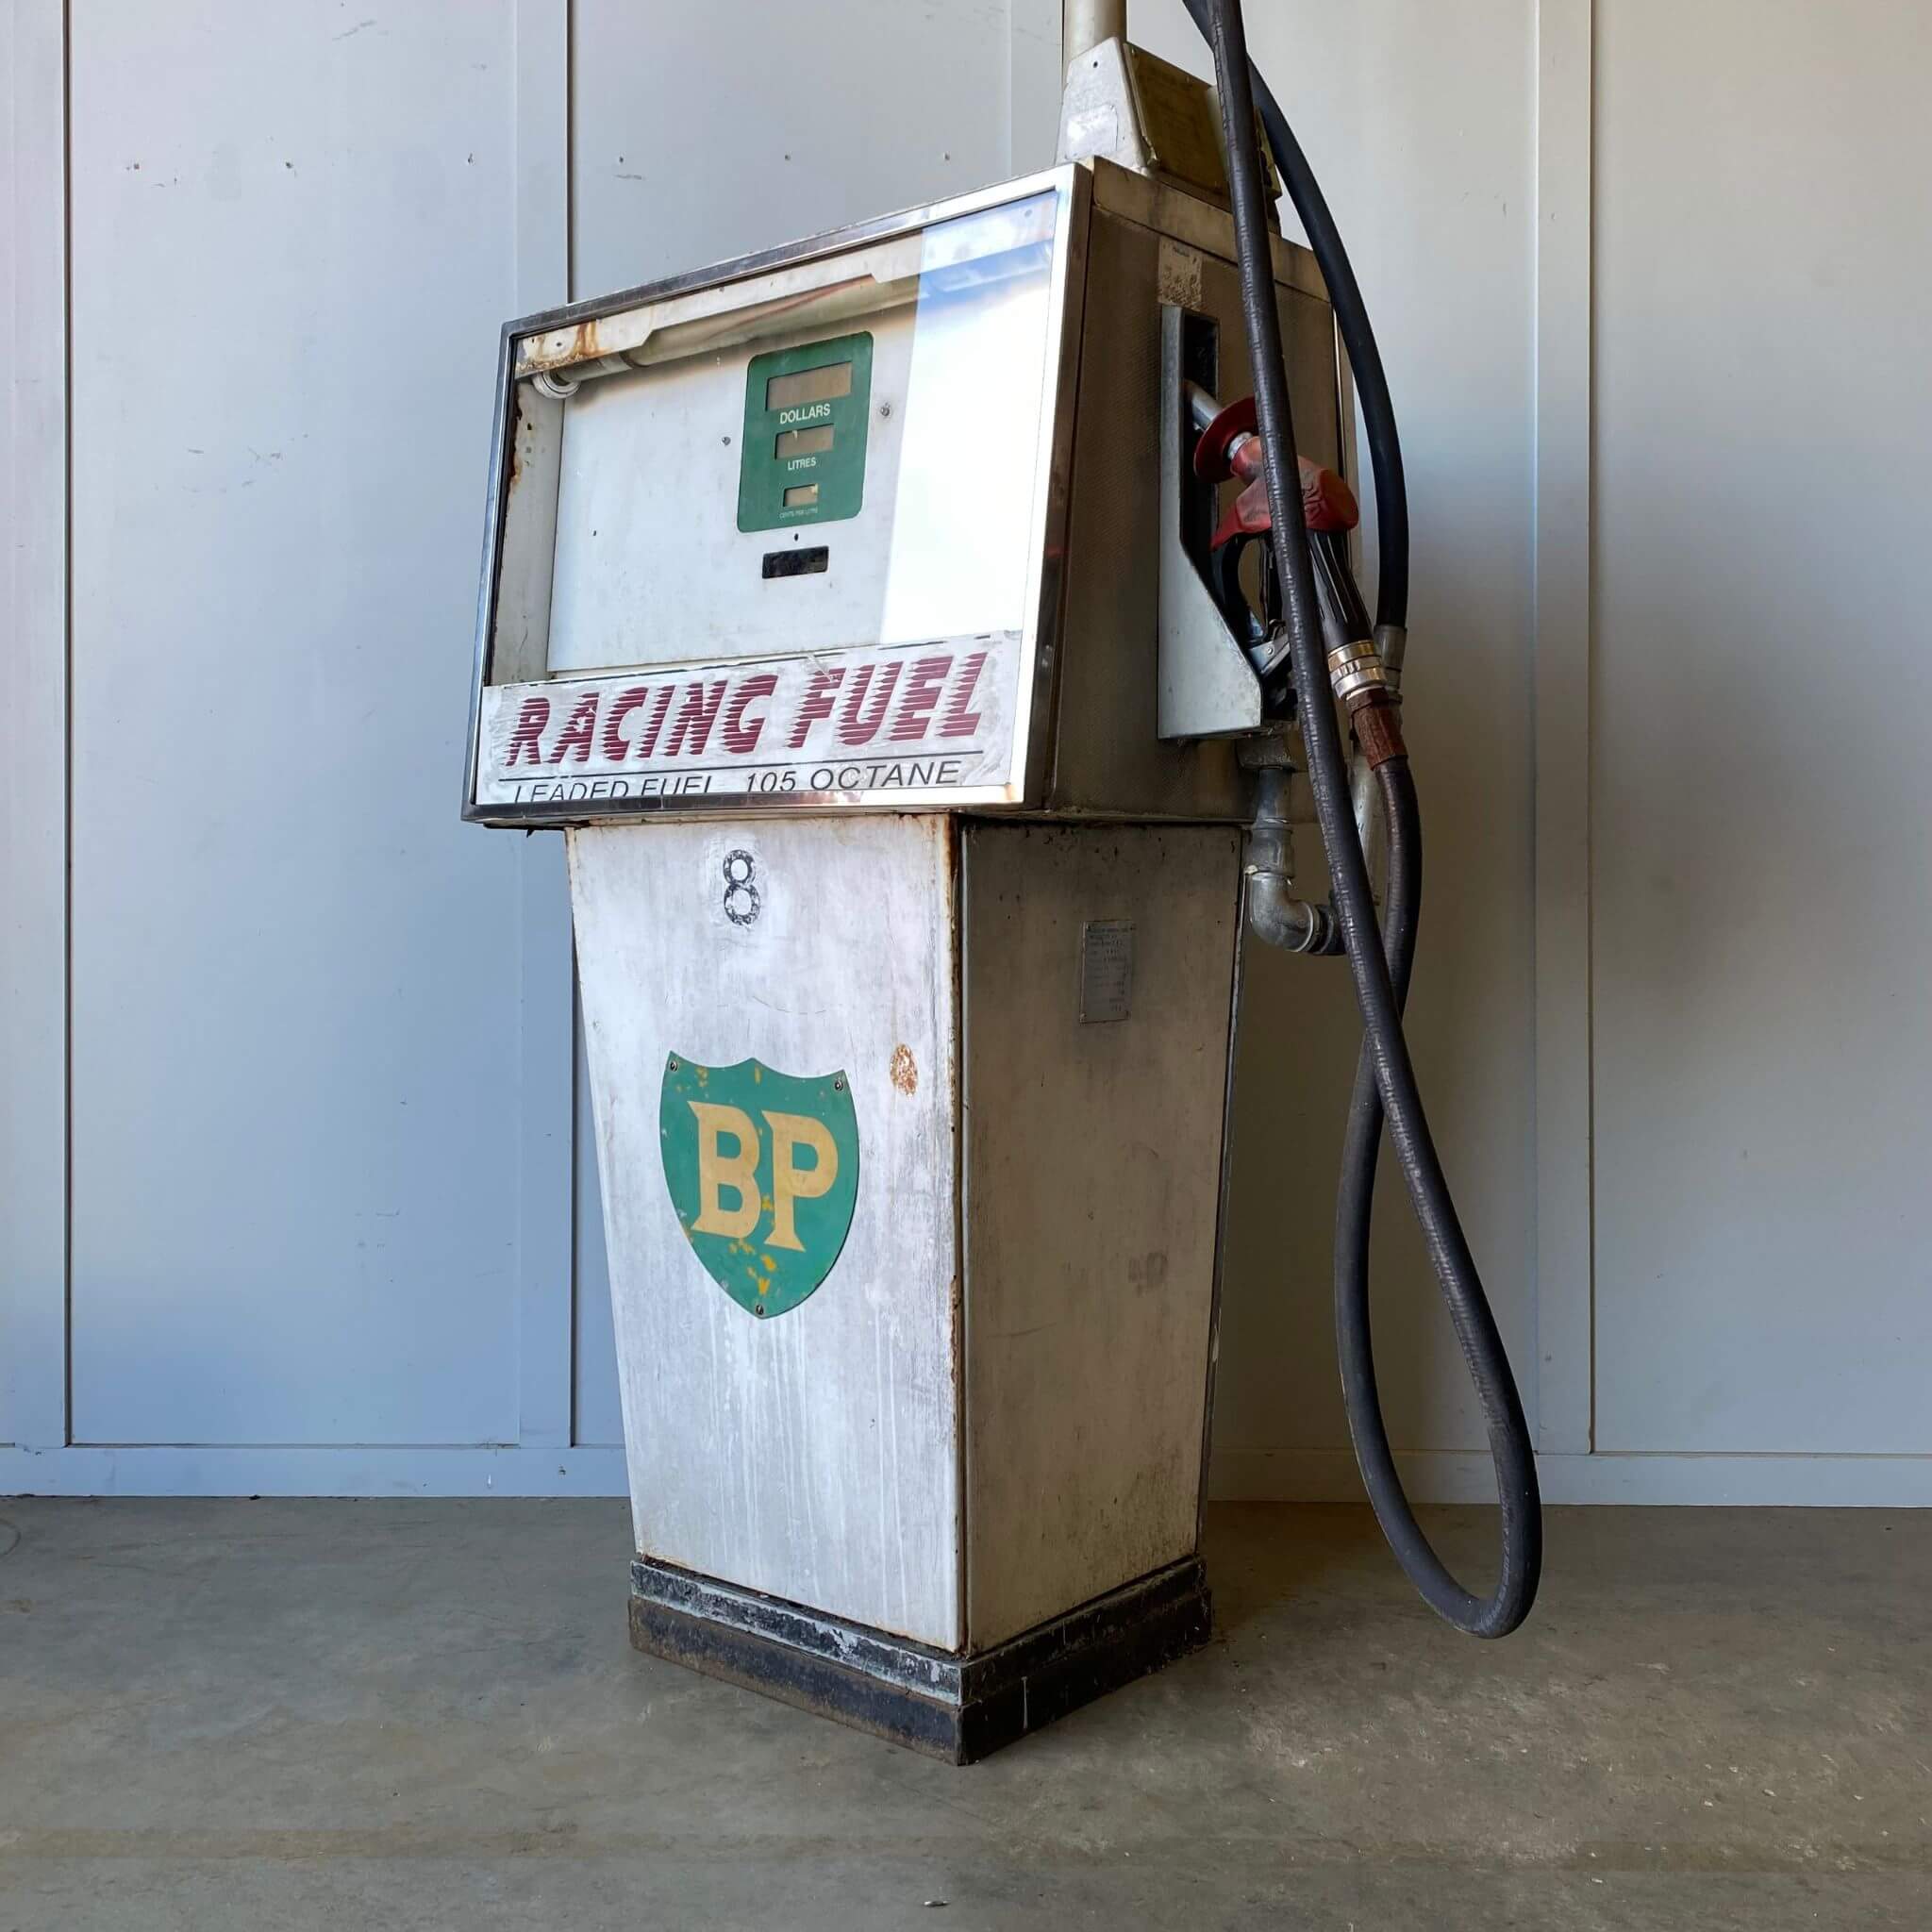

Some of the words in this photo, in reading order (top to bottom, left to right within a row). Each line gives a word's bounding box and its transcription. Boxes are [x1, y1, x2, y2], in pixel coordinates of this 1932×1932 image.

[779, 403, 831, 425] DOLLARS
[787, 457, 817, 471] LITRES
[504, 674, 778, 768] RACING
[784, 651, 989, 749] FUEL
[514, 780, 629, 803] LEADED
[641, 775, 712, 796] FUEL
[747, 771, 797, 792] 105
[809, 760, 962, 791] OCTANE
[723, 849, 761, 925] 8
[687, 1101, 839, 1252] BP
